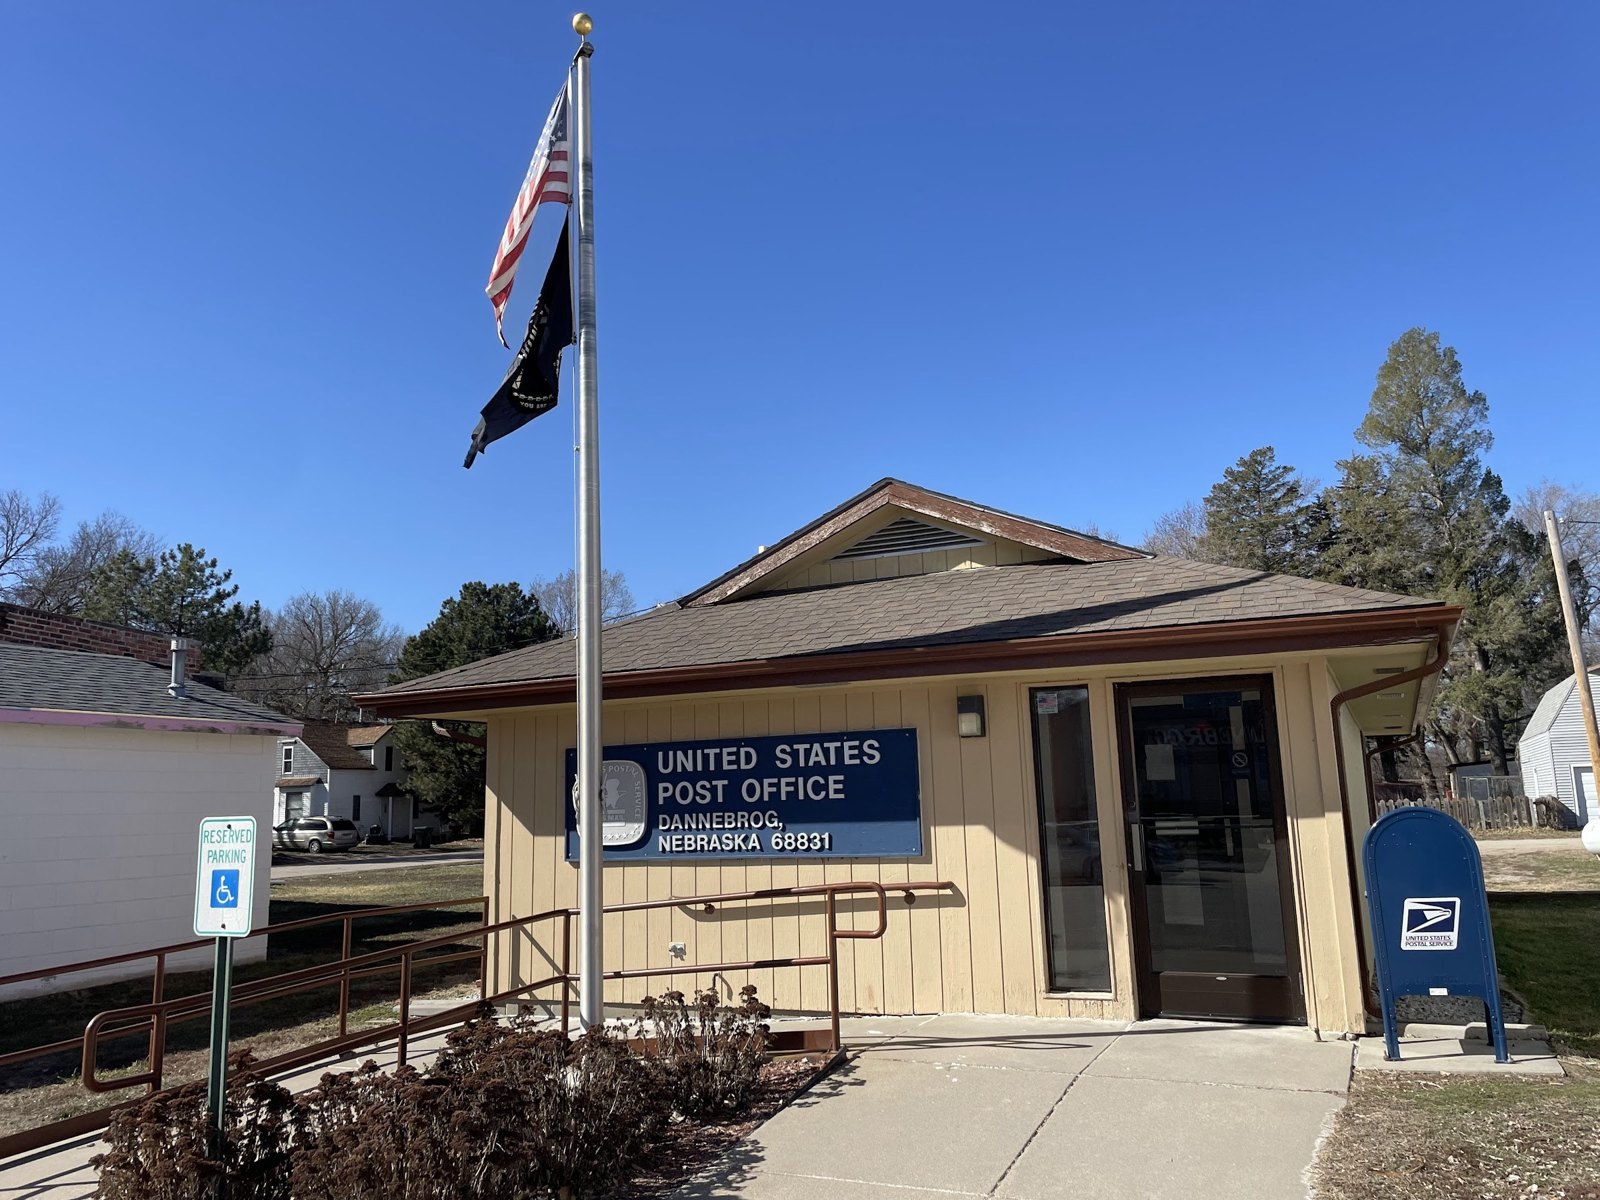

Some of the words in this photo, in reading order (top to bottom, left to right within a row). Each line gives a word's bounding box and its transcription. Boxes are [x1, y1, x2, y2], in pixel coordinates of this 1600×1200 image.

[657, 747, 758, 774] UNITED
[775, 739, 881, 769] STATES
[608, 765, 639, 777] POSTAL
[634, 780, 642, 819] SERVICE
[658, 780, 729, 805] POST
[741, 775, 846, 802] OFFICE
[658, 810, 783, 831] DANNEBROG,
[203, 829, 252, 843] RESERVED
[658, 833, 761, 852] NEBRASKA
[771, 832, 832, 850] 68831
[207, 849, 246, 863] PARKING
